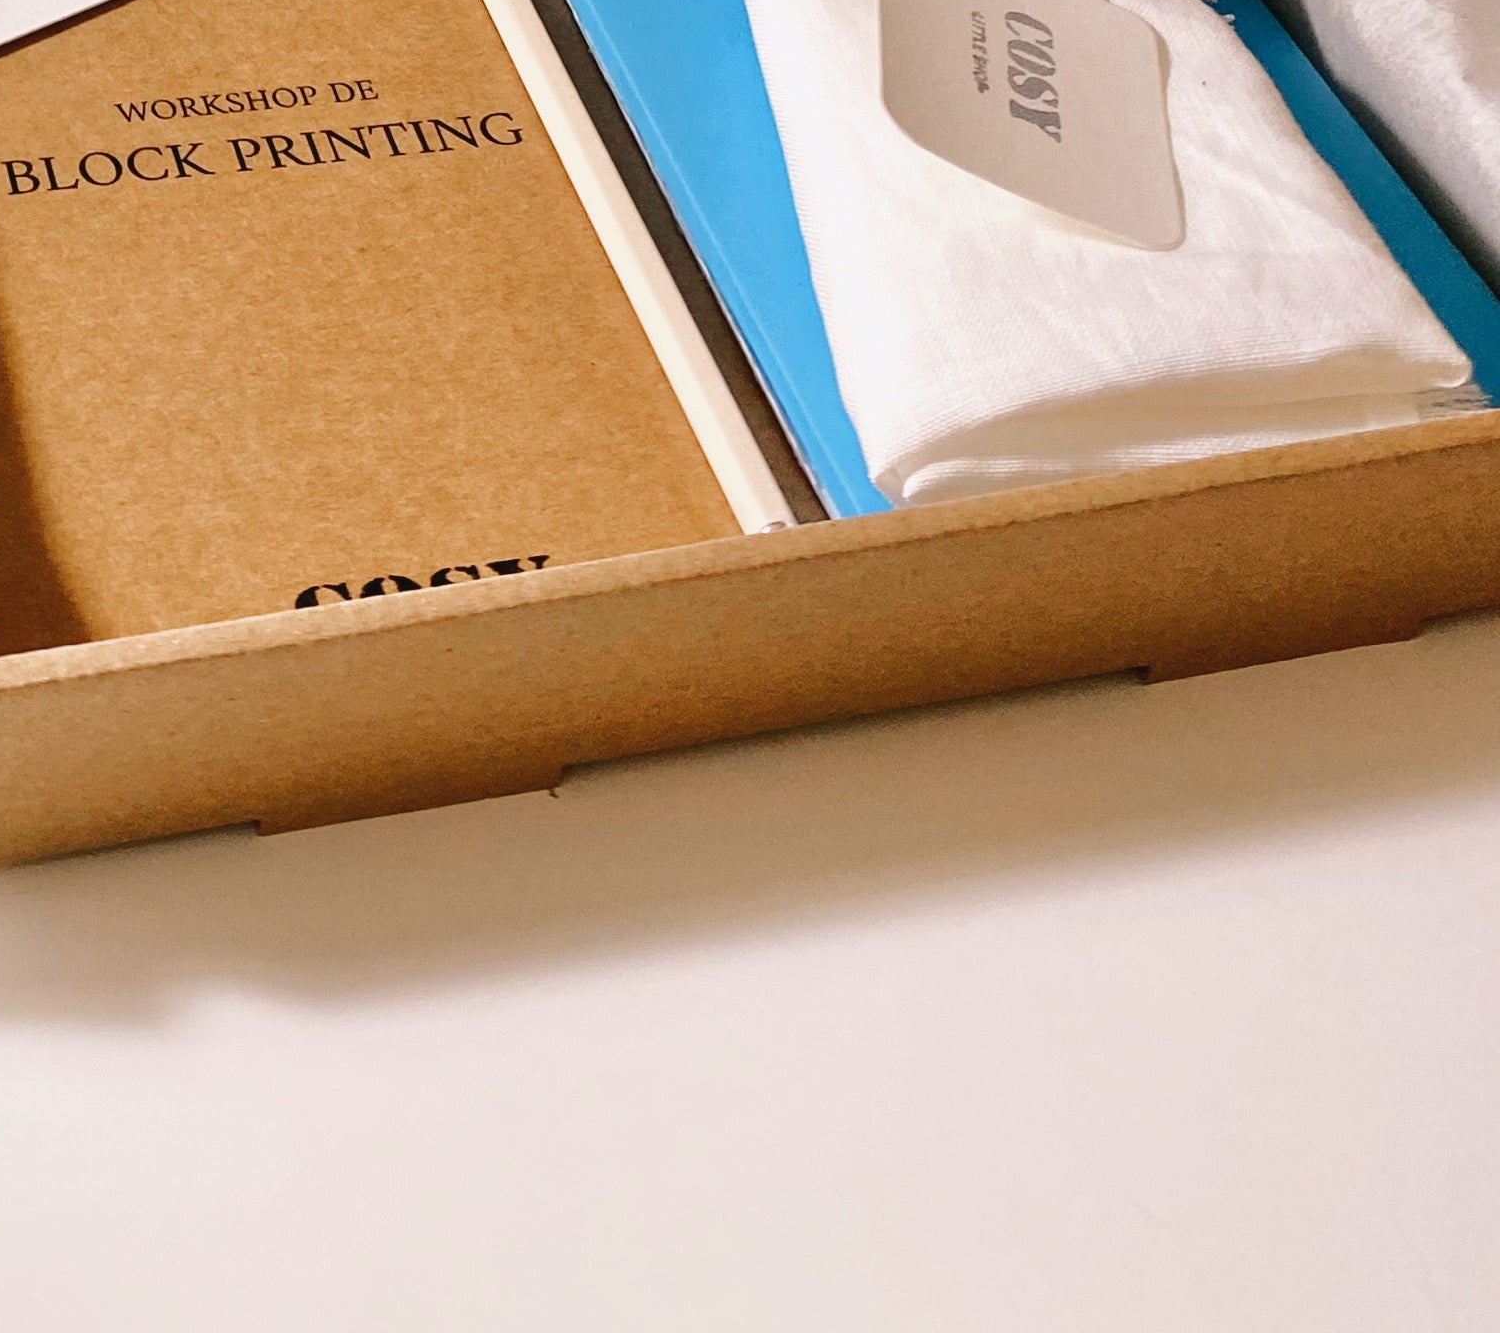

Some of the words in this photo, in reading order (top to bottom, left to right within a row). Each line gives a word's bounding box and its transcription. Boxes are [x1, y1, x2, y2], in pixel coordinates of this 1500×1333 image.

[114, 83, 318, 124] WORKSHOP
[329, 79, 380, 104] DE
[1004, 11, 1062, 143] COSY
[0, 142, 215, 196] BLOCK
[227, 111, 524, 174] PRINTING
